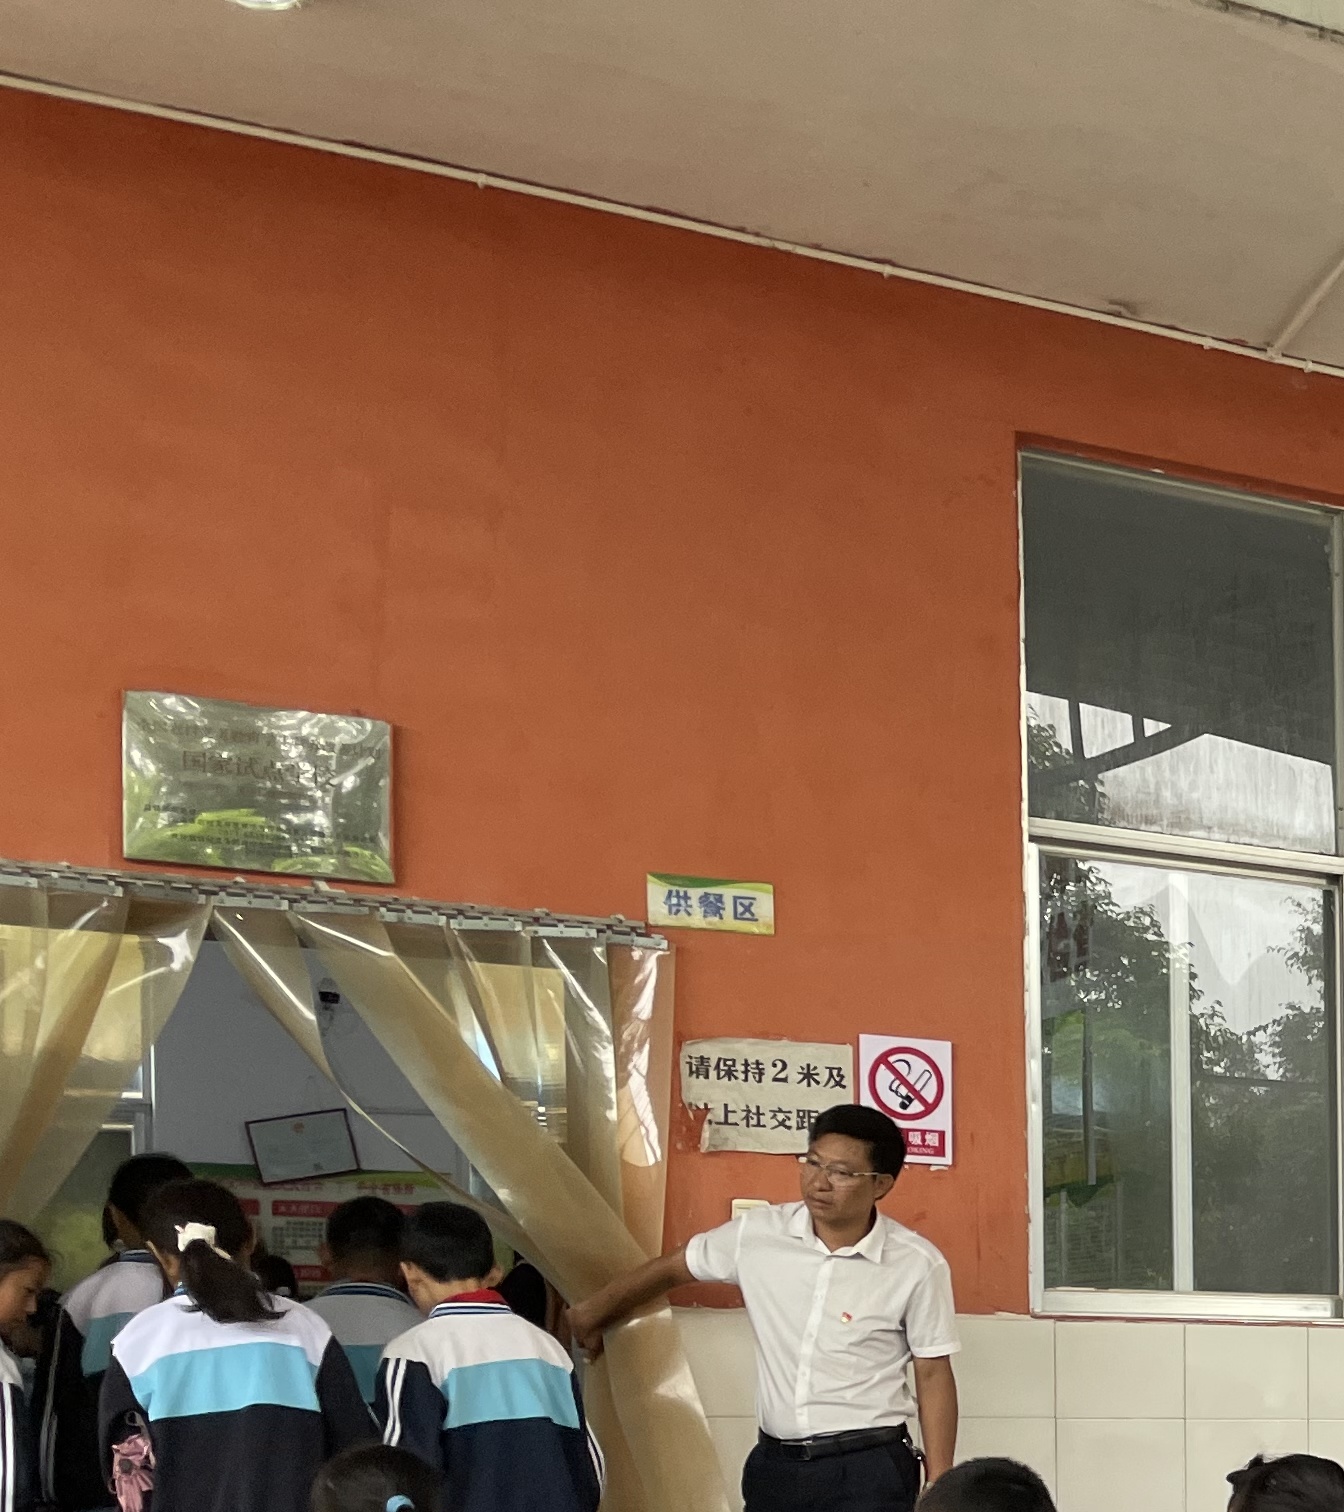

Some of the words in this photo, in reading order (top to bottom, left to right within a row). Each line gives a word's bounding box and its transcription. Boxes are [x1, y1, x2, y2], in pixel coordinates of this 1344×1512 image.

[663, 888, 759, 922] 供餐区
[685, 1054, 847, 1090] 请保持2米及
[688, 1101, 819, 1132] 上社交距
[906, 1131, 939, 1147] 吸烟
[906, 1146, 935, 1155] OKING
